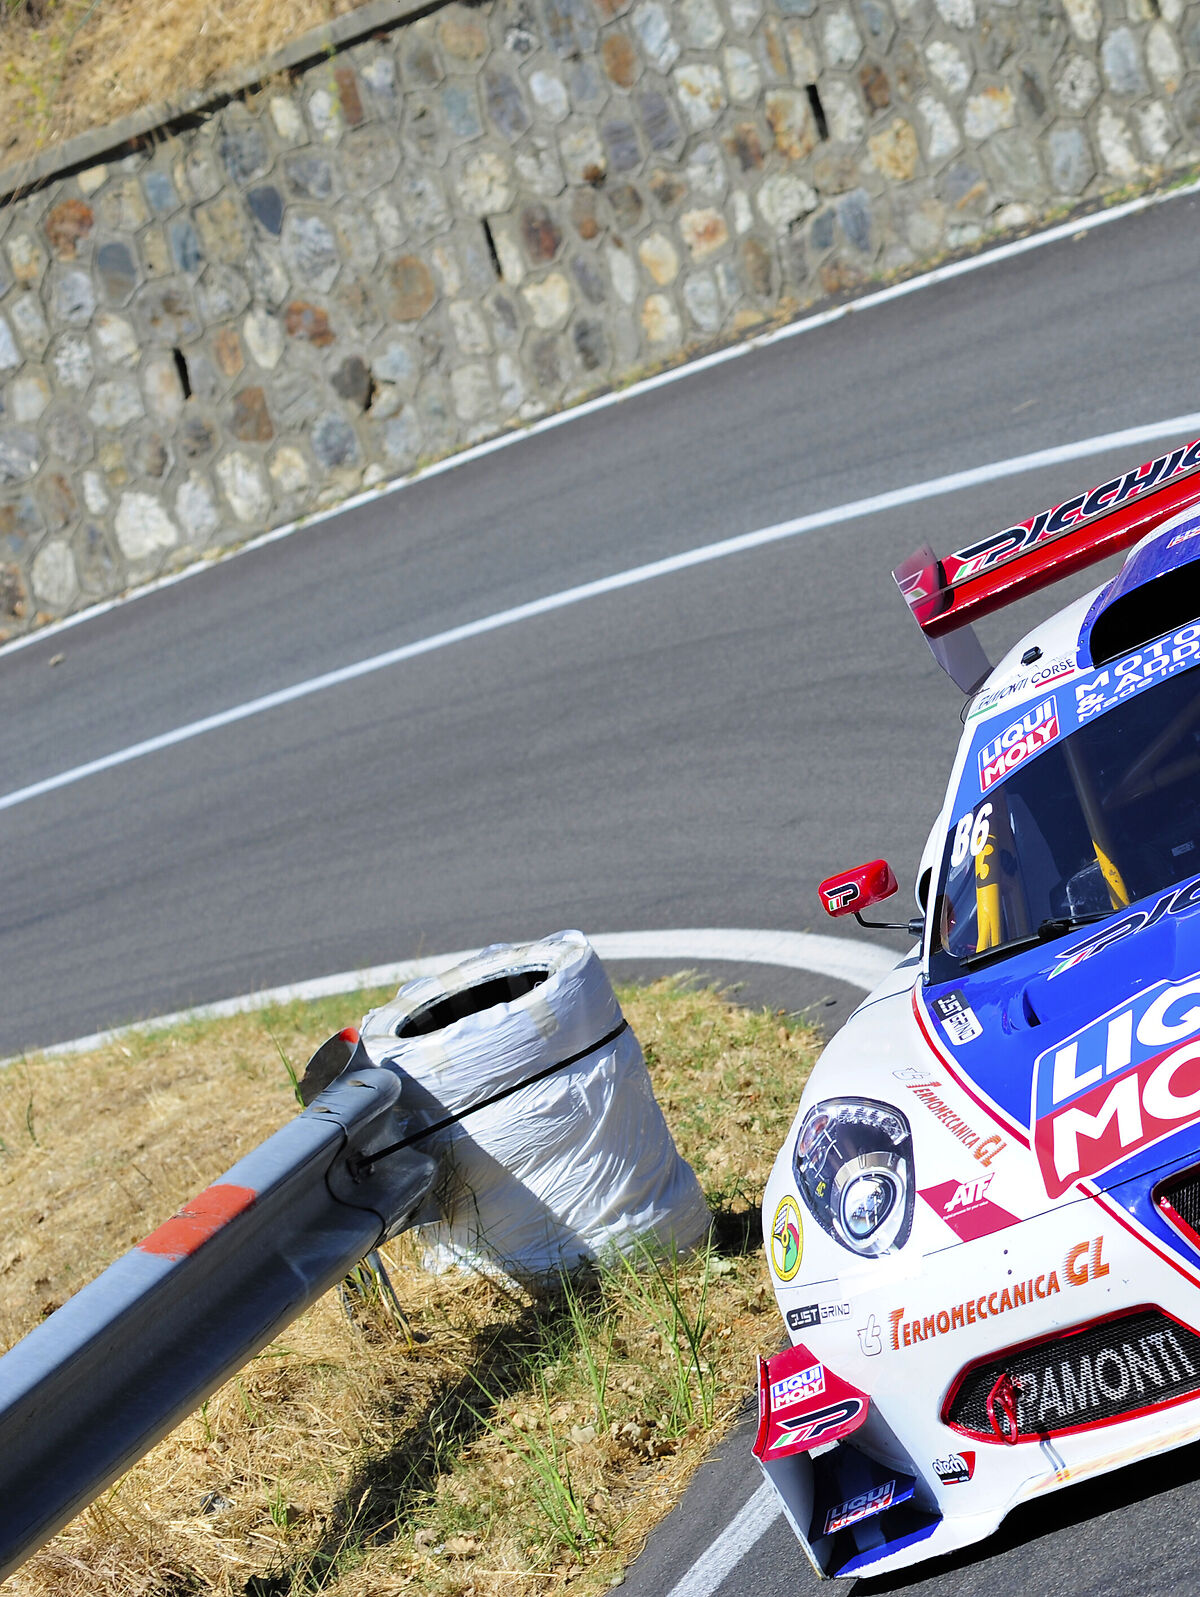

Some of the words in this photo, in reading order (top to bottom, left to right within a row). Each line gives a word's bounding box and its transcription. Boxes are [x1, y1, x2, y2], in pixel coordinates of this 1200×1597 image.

[1031, 658, 1076, 684] CORSE
[1077, 692, 1107, 714] &
[1078, 677, 1154, 723] Made
[1160, 660, 1186, 677] in
[982, 700, 1052, 768] LIQUI
[984, 718, 1056, 787] MOLY
[906, 1080, 980, 1150] TERMOMECCANICA
[943, 1172, 996, 1213] ATF
[888, 1270, 1061, 1351] TERMOMECCANICA
[1062, 1235, 1110, 1288] GL
[790, 1307, 818, 1327] JUST
[820, 1303, 850, 1319] GRIND
[773, 1365, 822, 1397] LIQUI
[774, 1379, 824, 1409] MOLY
[830, 1481, 892, 1519] LIQUI
